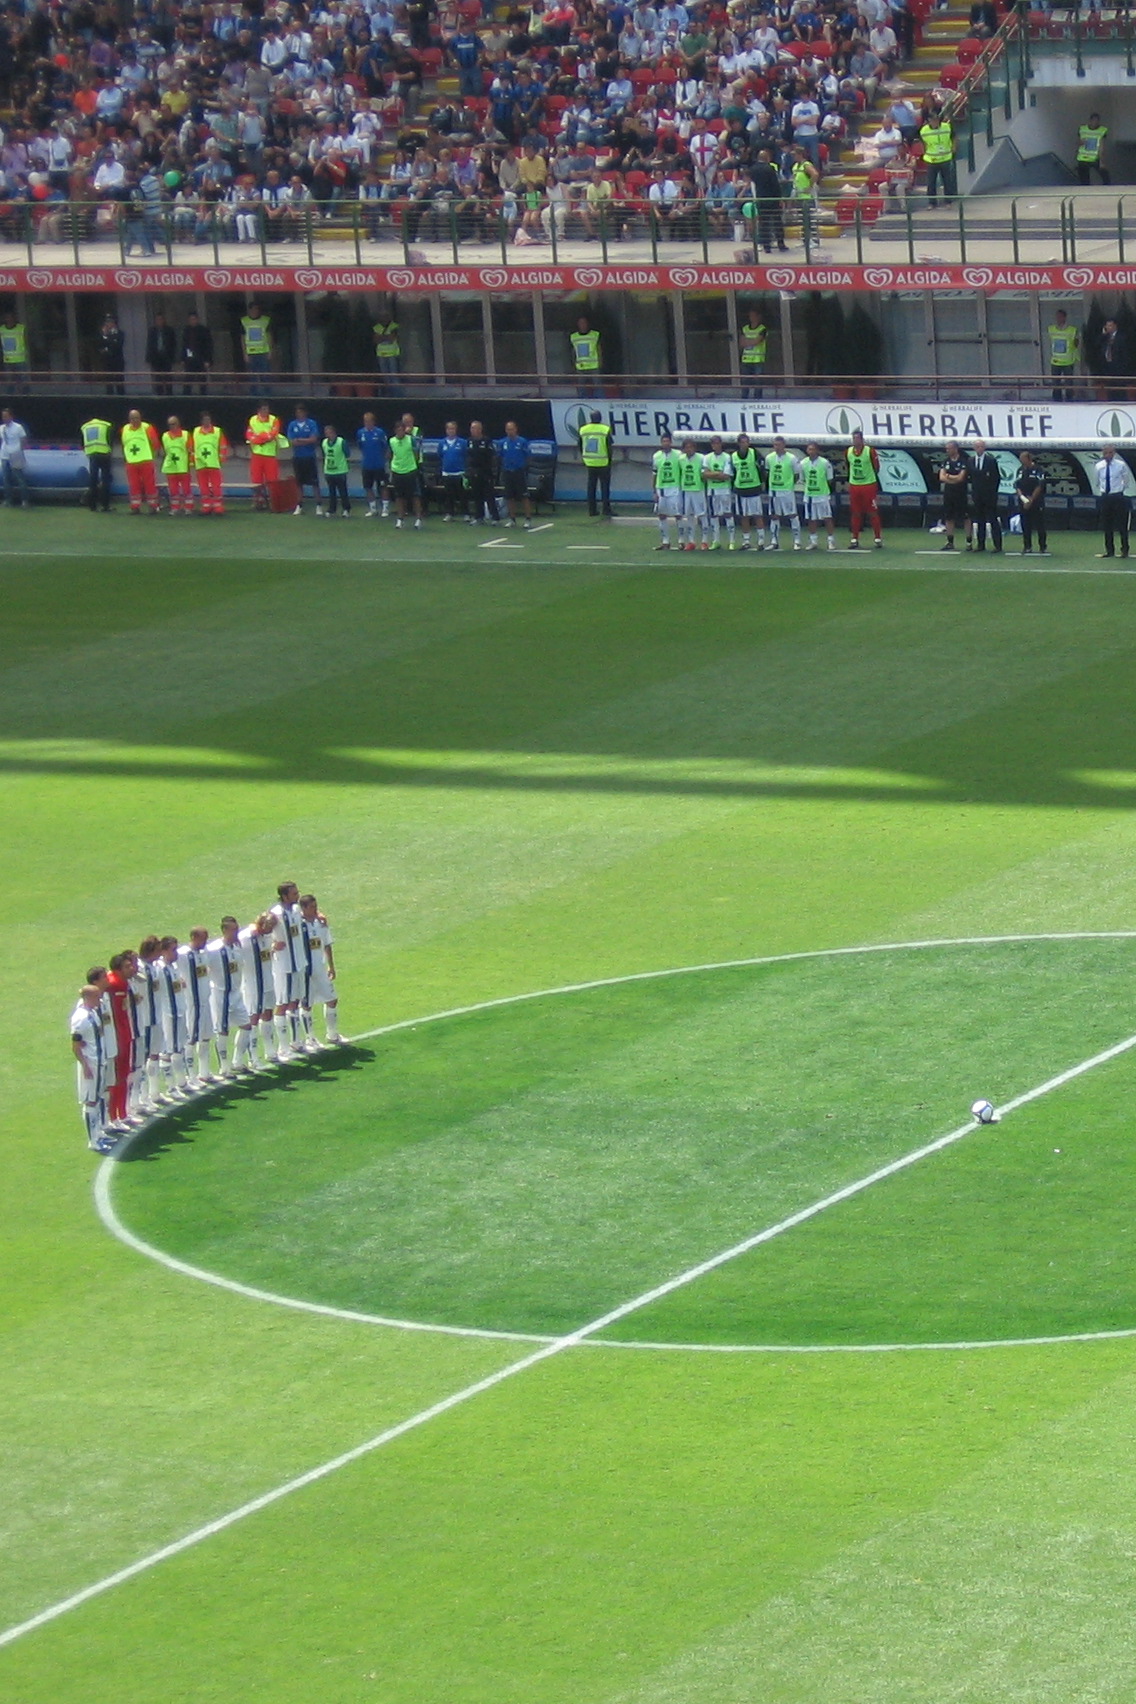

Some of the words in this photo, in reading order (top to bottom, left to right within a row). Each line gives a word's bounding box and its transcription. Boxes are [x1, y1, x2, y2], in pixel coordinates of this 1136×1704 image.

[55, 273, 104, 286] ALGIDA
[144, 273, 193, 286] ALGIDA
[233, 273, 283, 286] ALGIDA
[324, 273, 374, 285] ALGIDA
[416, 273, 468, 285] ALGIDA
[511, 273, 563, 285] ALGIDA
[605, 272, 657, 285] ALGIDA
[701, 272, 754, 285] ALGIDA
[798, 272, 851, 285] ALGIDA
[895, 272, 951, 285] ALGIDA
[995, 272, 1051, 285] ALGIDA
[872, 413, 1054, 437] HERBALIFE
